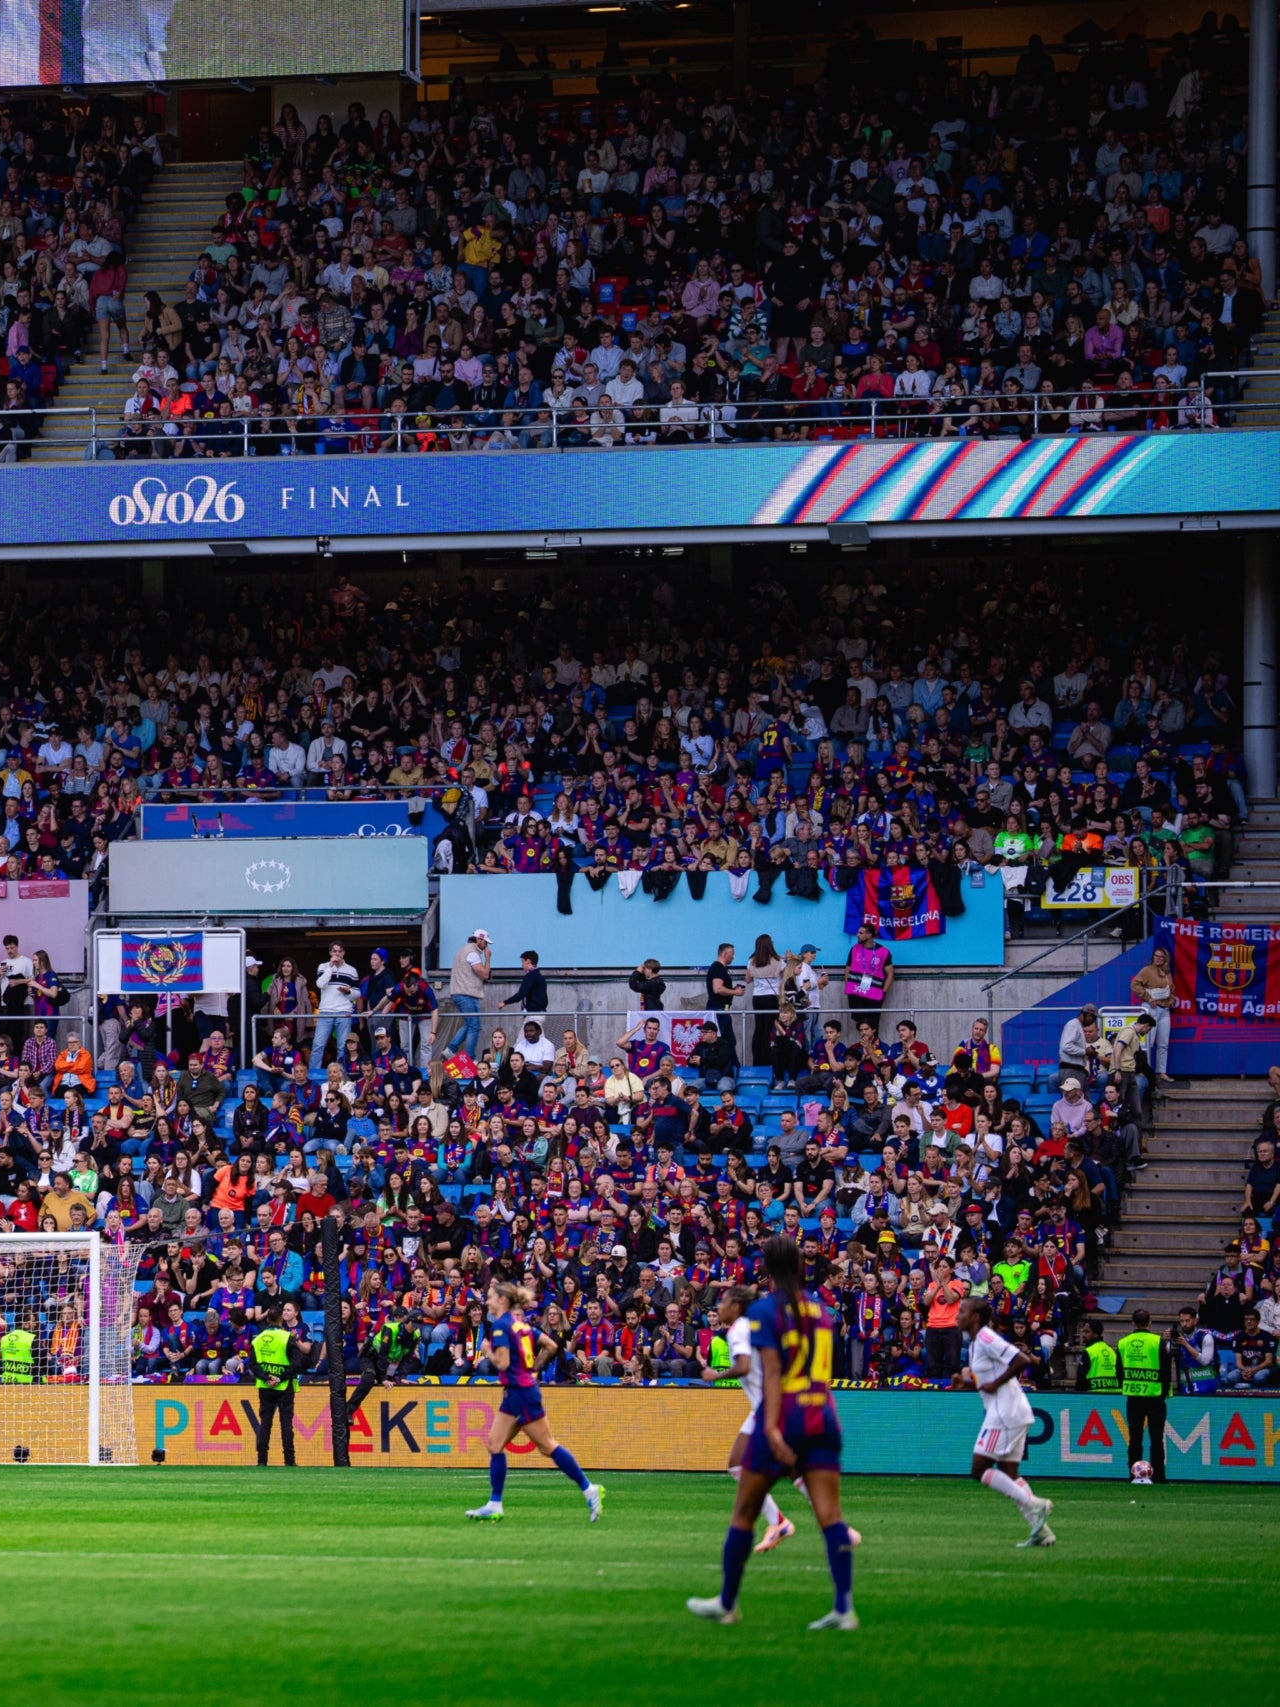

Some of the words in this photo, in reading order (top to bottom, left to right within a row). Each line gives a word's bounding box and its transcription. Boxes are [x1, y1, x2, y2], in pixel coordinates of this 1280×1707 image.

[281, 485, 410, 510] FINAL
[1111, 875, 1133, 885] OBS!
[864, 913, 877, 925] FC
[878, 909, 940, 928] BARCELONA
[1196, 997, 1238, 1014] Tour
[1107, 1019, 1123, 1028] 128
[1124, 1383, 1149, 1394] 7857
[155, 1399, 538, 1455] PLAMAKER
